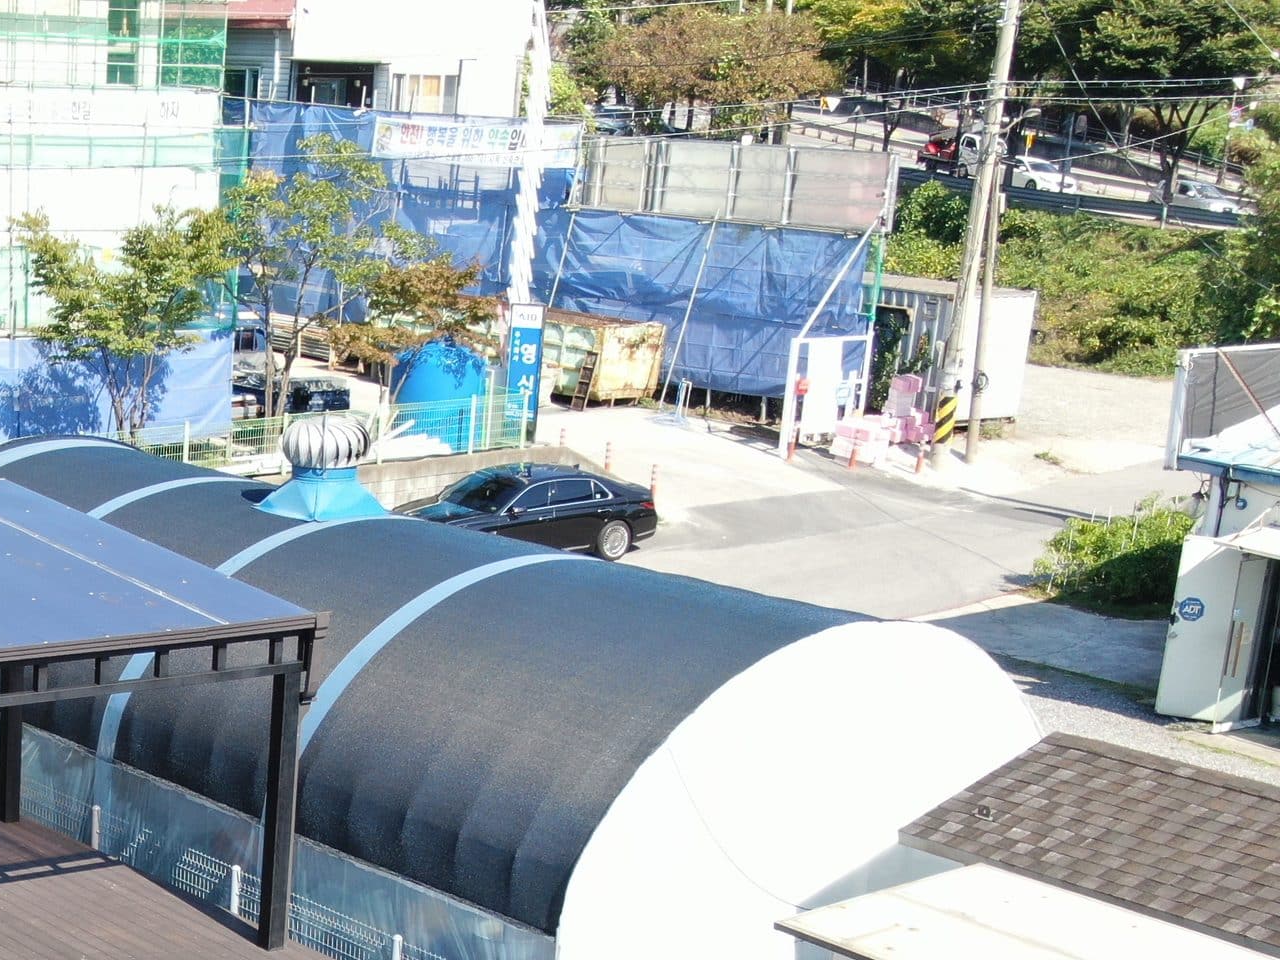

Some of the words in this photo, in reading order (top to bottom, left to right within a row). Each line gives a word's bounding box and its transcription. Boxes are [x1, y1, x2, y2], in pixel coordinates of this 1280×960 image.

[426, 125, 459, 148] 행복을
[461, 127, 484, 149] 위한
[1182, 605, 1202, 614] ADT
